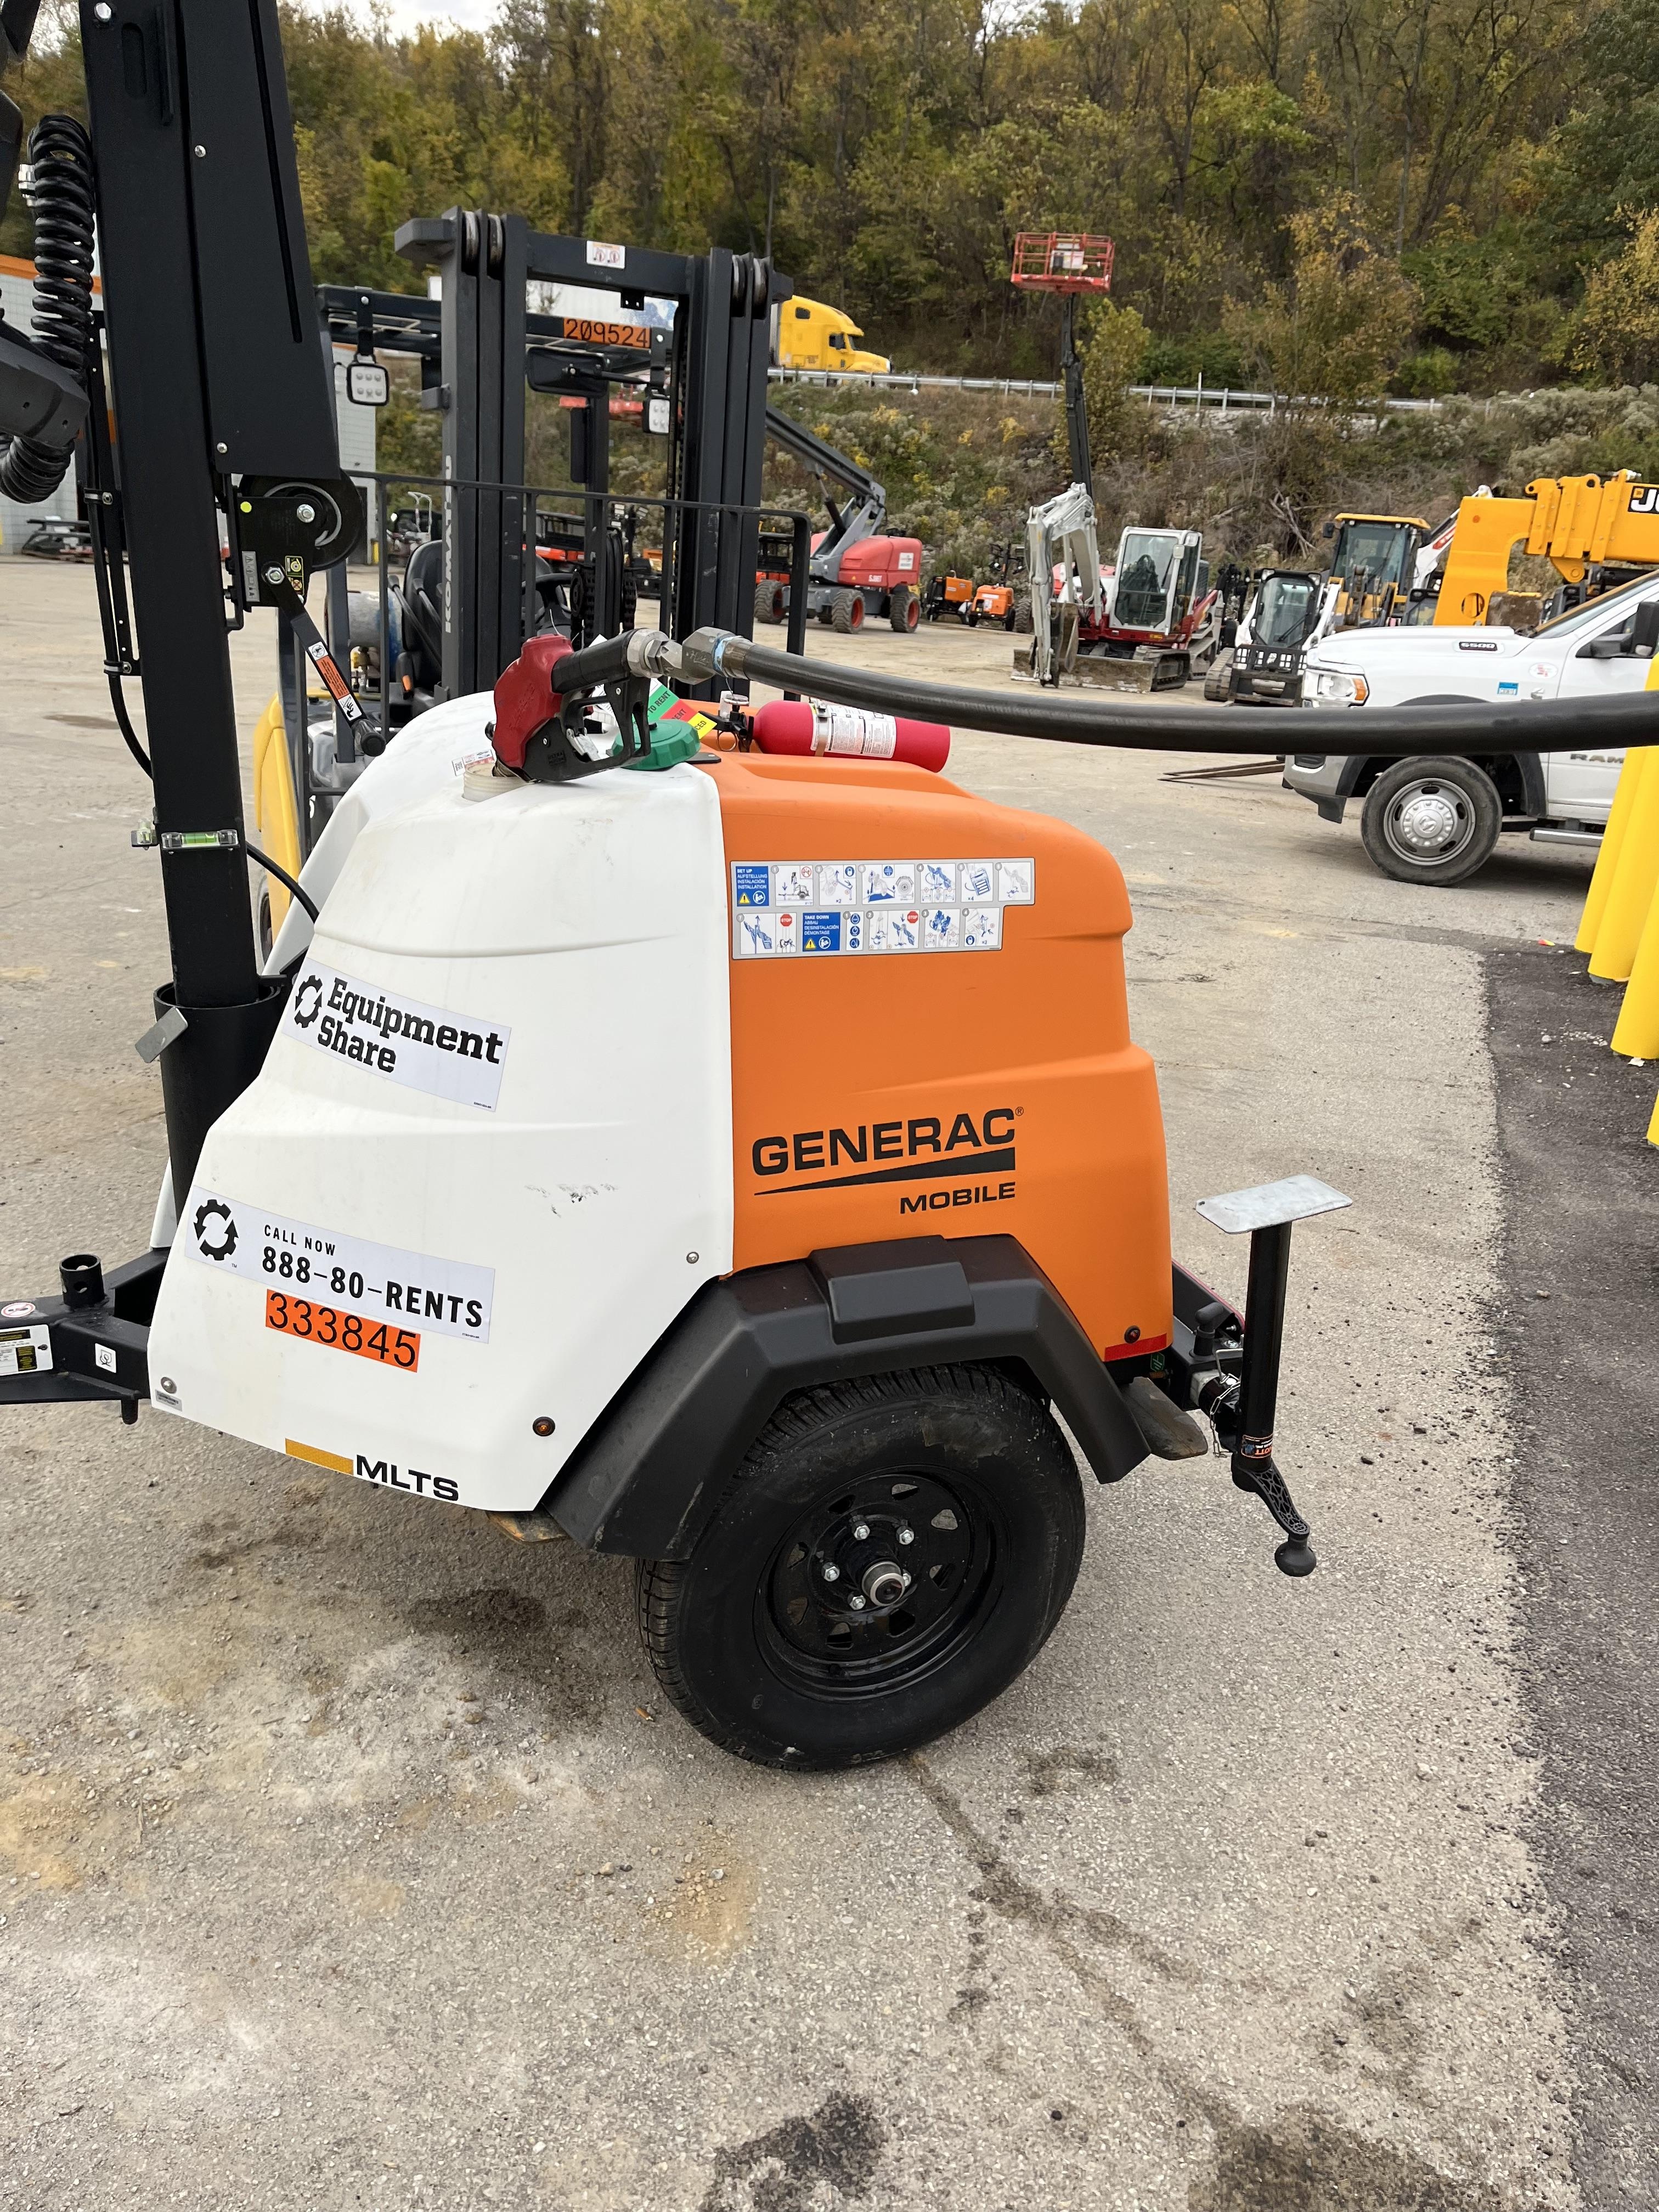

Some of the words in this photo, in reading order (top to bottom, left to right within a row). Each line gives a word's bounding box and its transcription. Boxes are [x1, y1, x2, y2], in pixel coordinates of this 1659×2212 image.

[566, 318, 648, 348] 209524
[443, 455, 452, 633] KOMATSU
[655, 690, 671, 707] RENT
[317, 1015, 396, 1073] Share
[328, 977, 504, 1065] Equipment
[752, 1108, 1015, 1176] GENERAC
[900, 1181, 1015, 1215] MOBILE
[264, 1224, 297, 1246] CALL
[304, 1237, 336, 1257] NOW
[262, 1246, 483, 1329] 888-80-RENTS
[269, 1292, 417, 1368] 333845
[357, 1454, 459, 1503] MLTS
